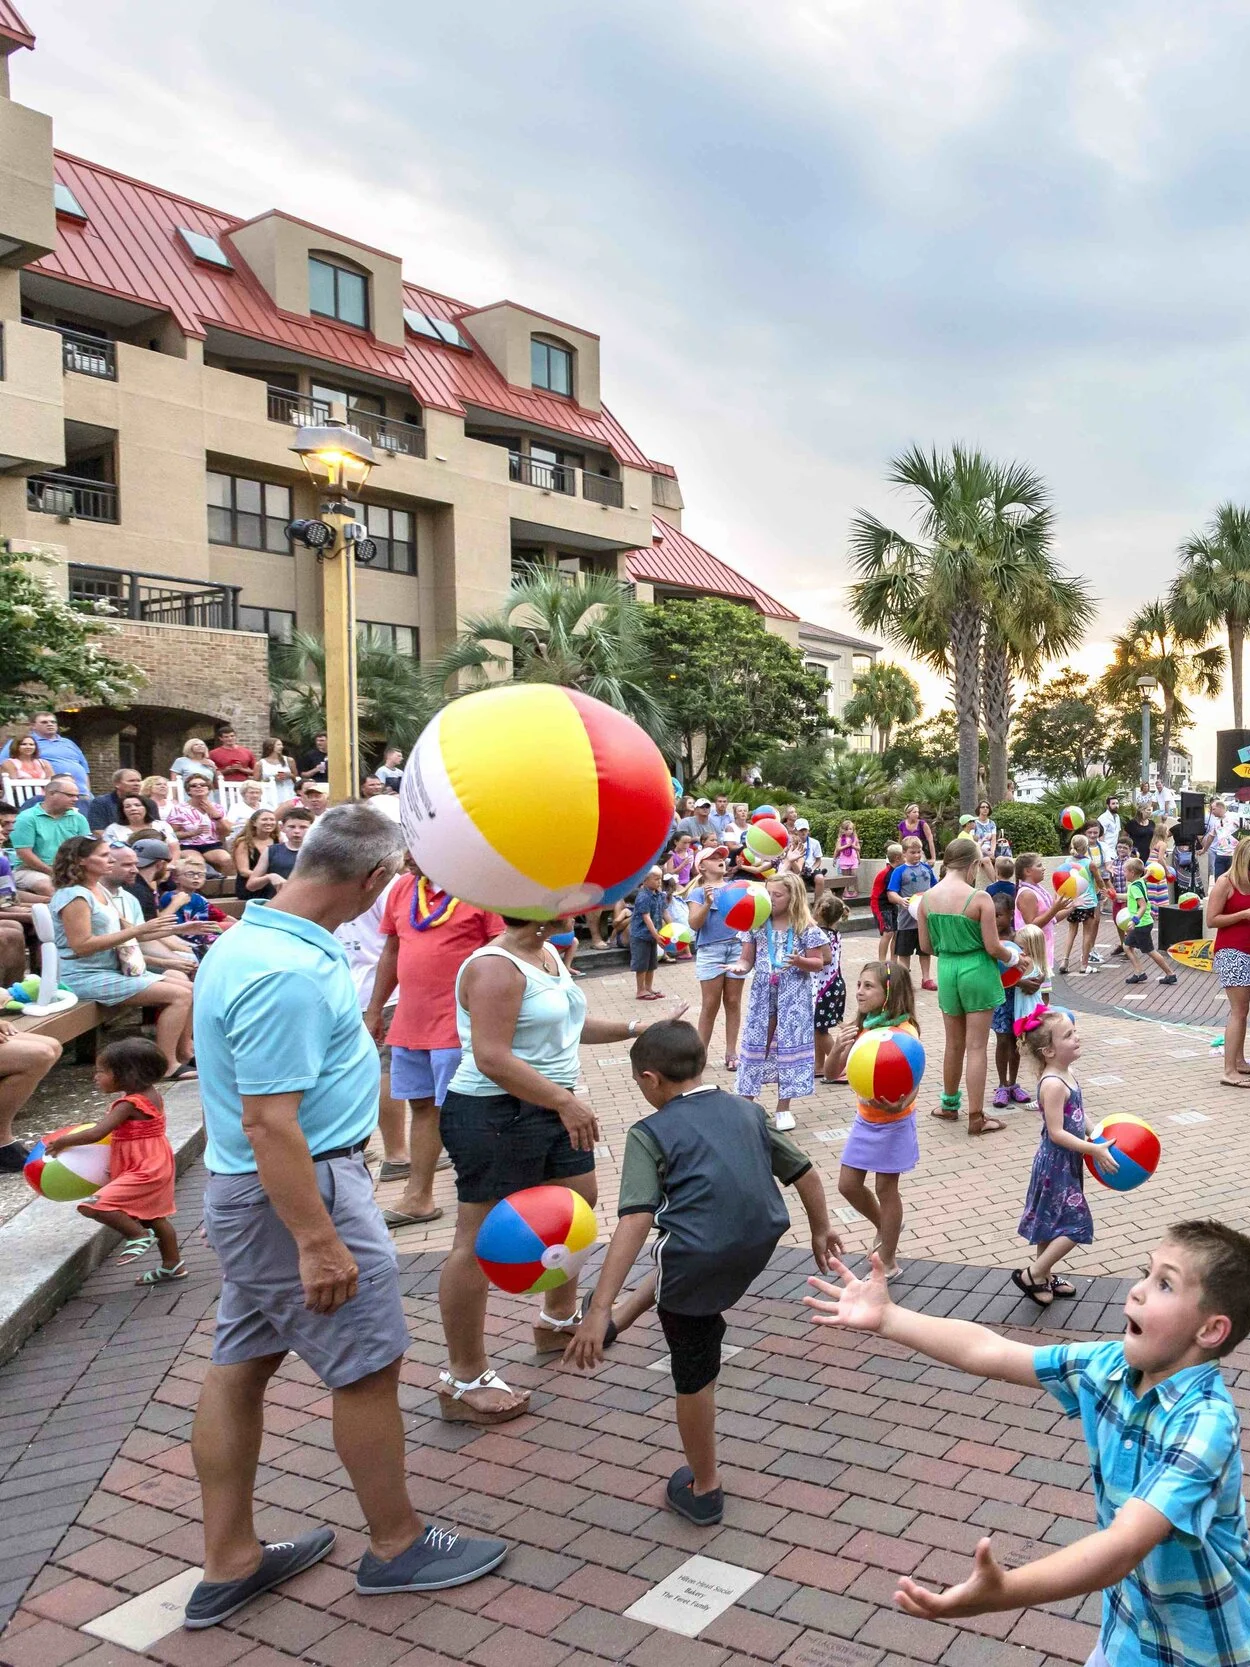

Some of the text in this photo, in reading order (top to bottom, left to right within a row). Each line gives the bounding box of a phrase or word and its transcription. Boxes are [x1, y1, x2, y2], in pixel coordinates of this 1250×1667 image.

[677, 1575, 734, 1595] Hilton Head Social
[684, 1588, 706, 1599] Bakery
[662, 1591, 712, 1612] The Feret Family
